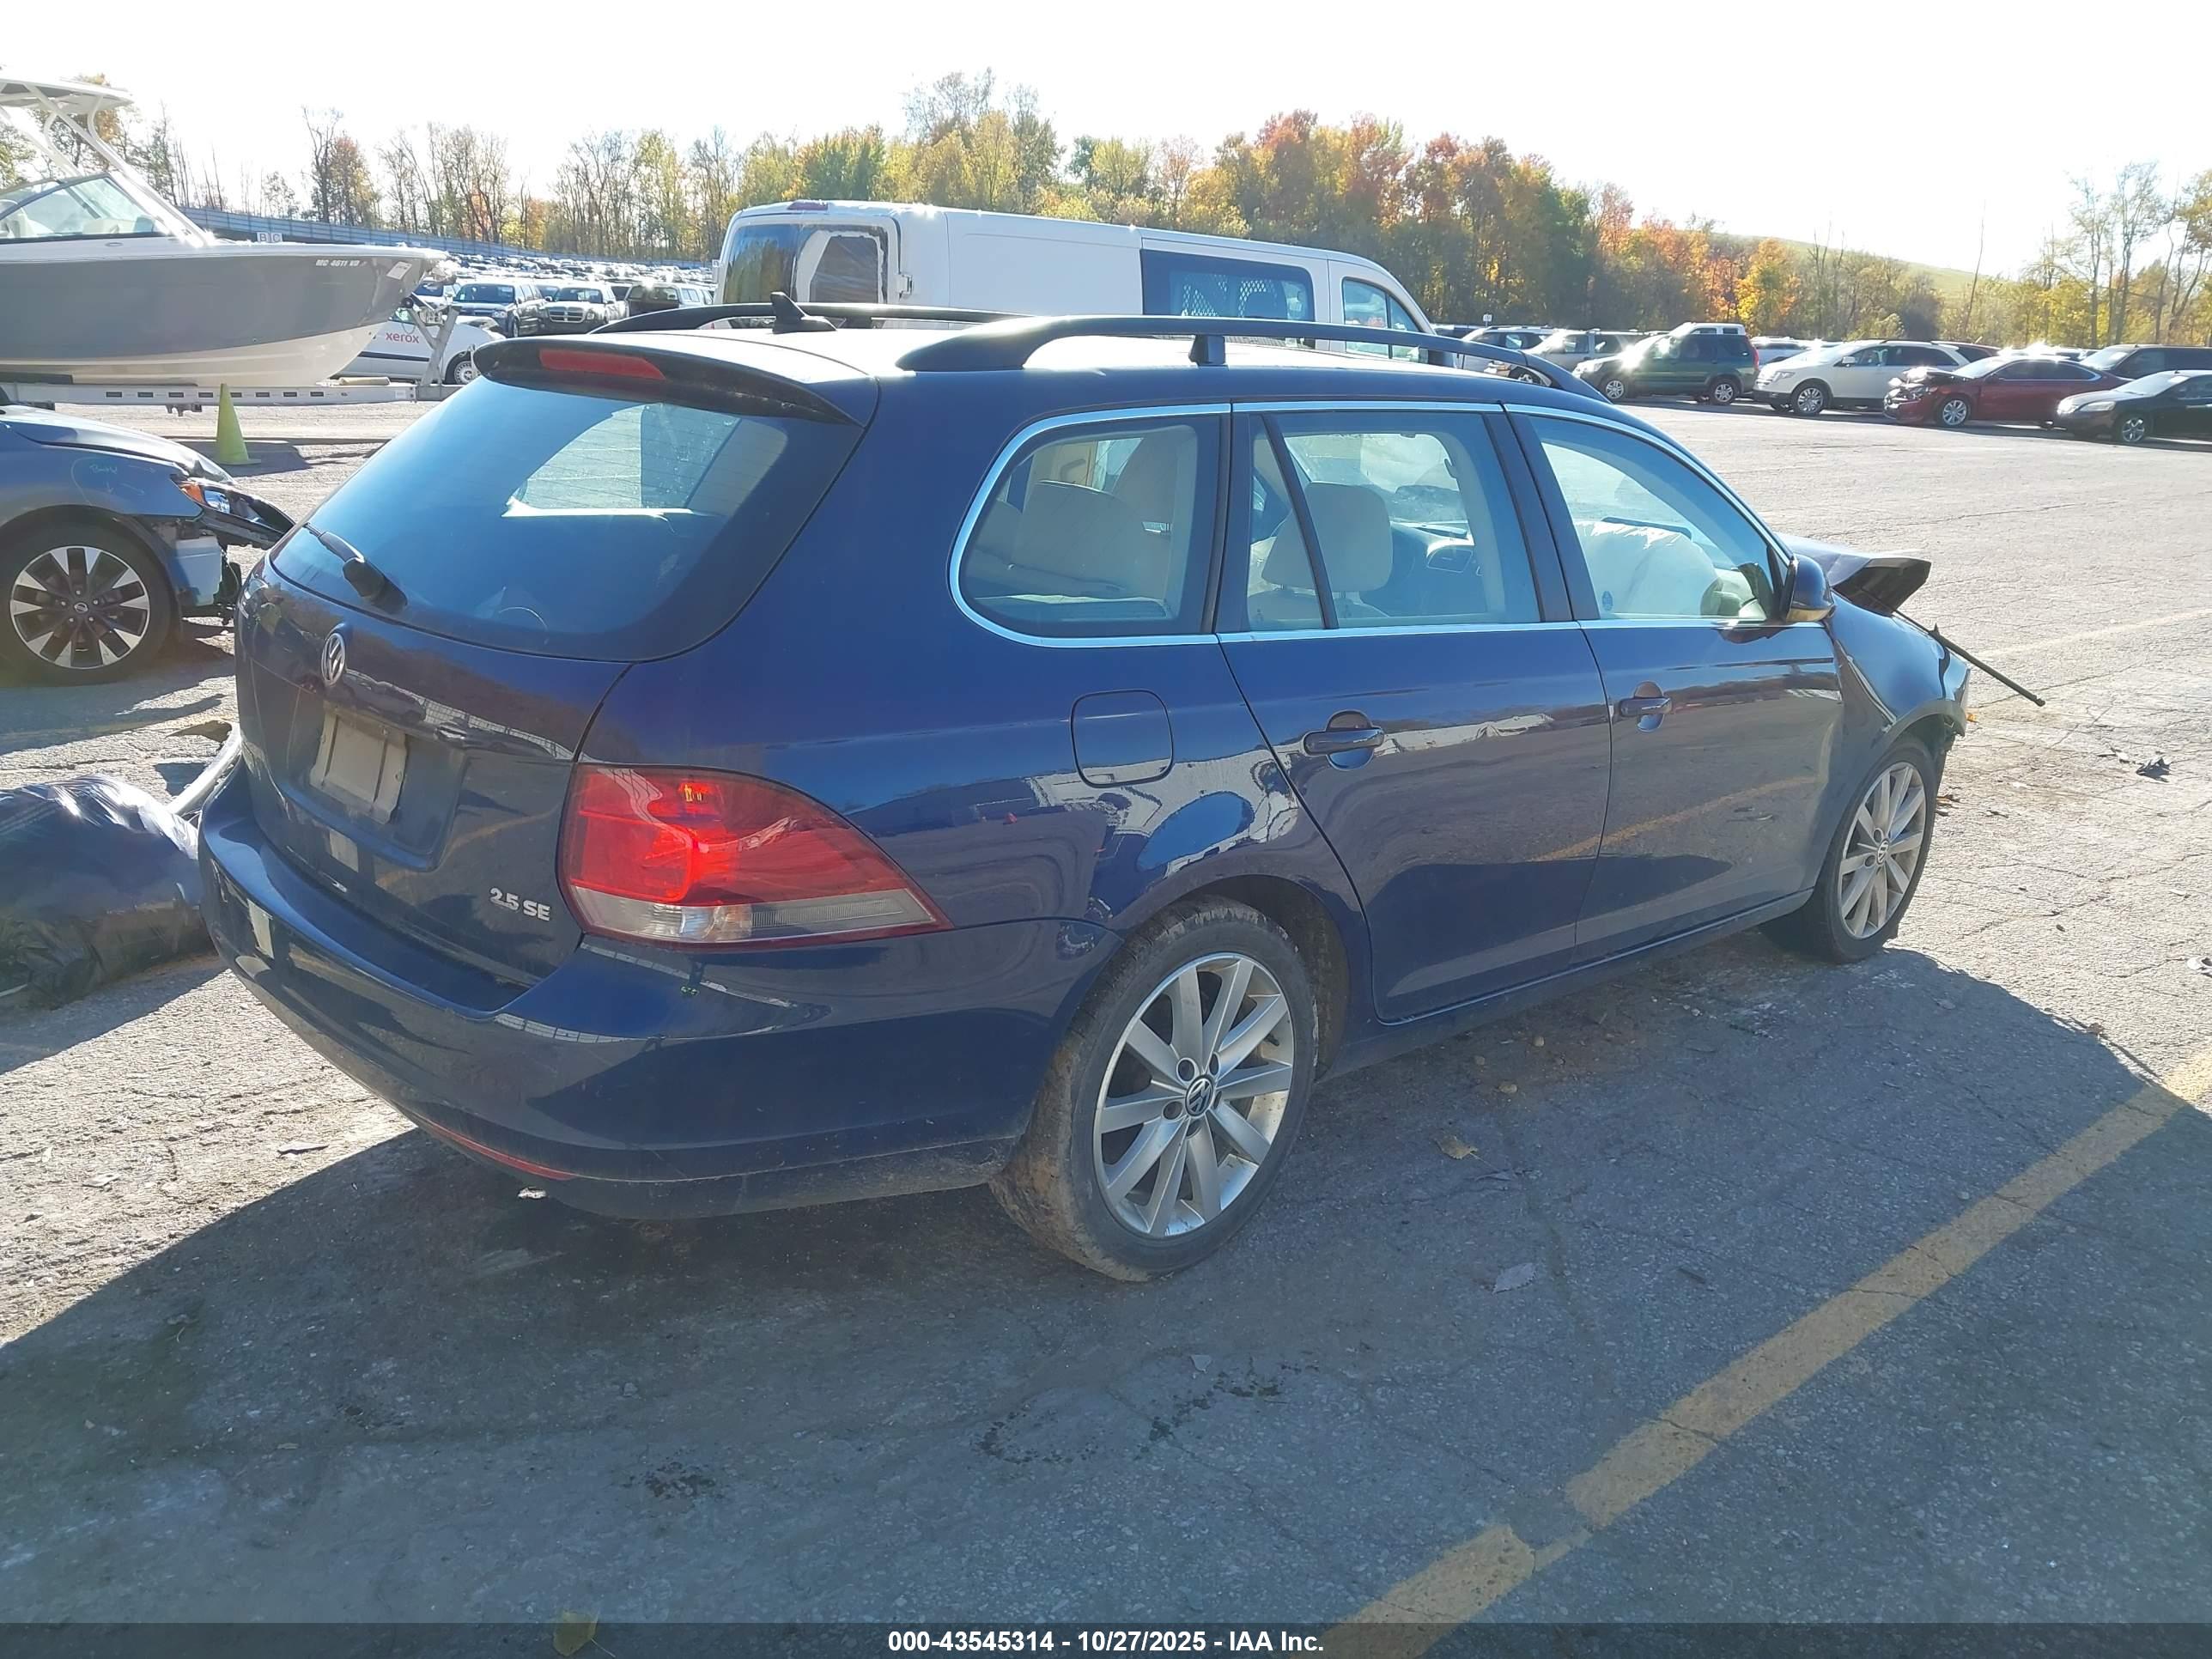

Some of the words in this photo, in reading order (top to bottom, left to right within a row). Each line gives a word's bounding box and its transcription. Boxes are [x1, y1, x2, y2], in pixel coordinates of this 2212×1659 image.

[260, 233, 267, 242] B
[386, 332, 420, 343] xerox
[522, 900, 550, 921] SE
